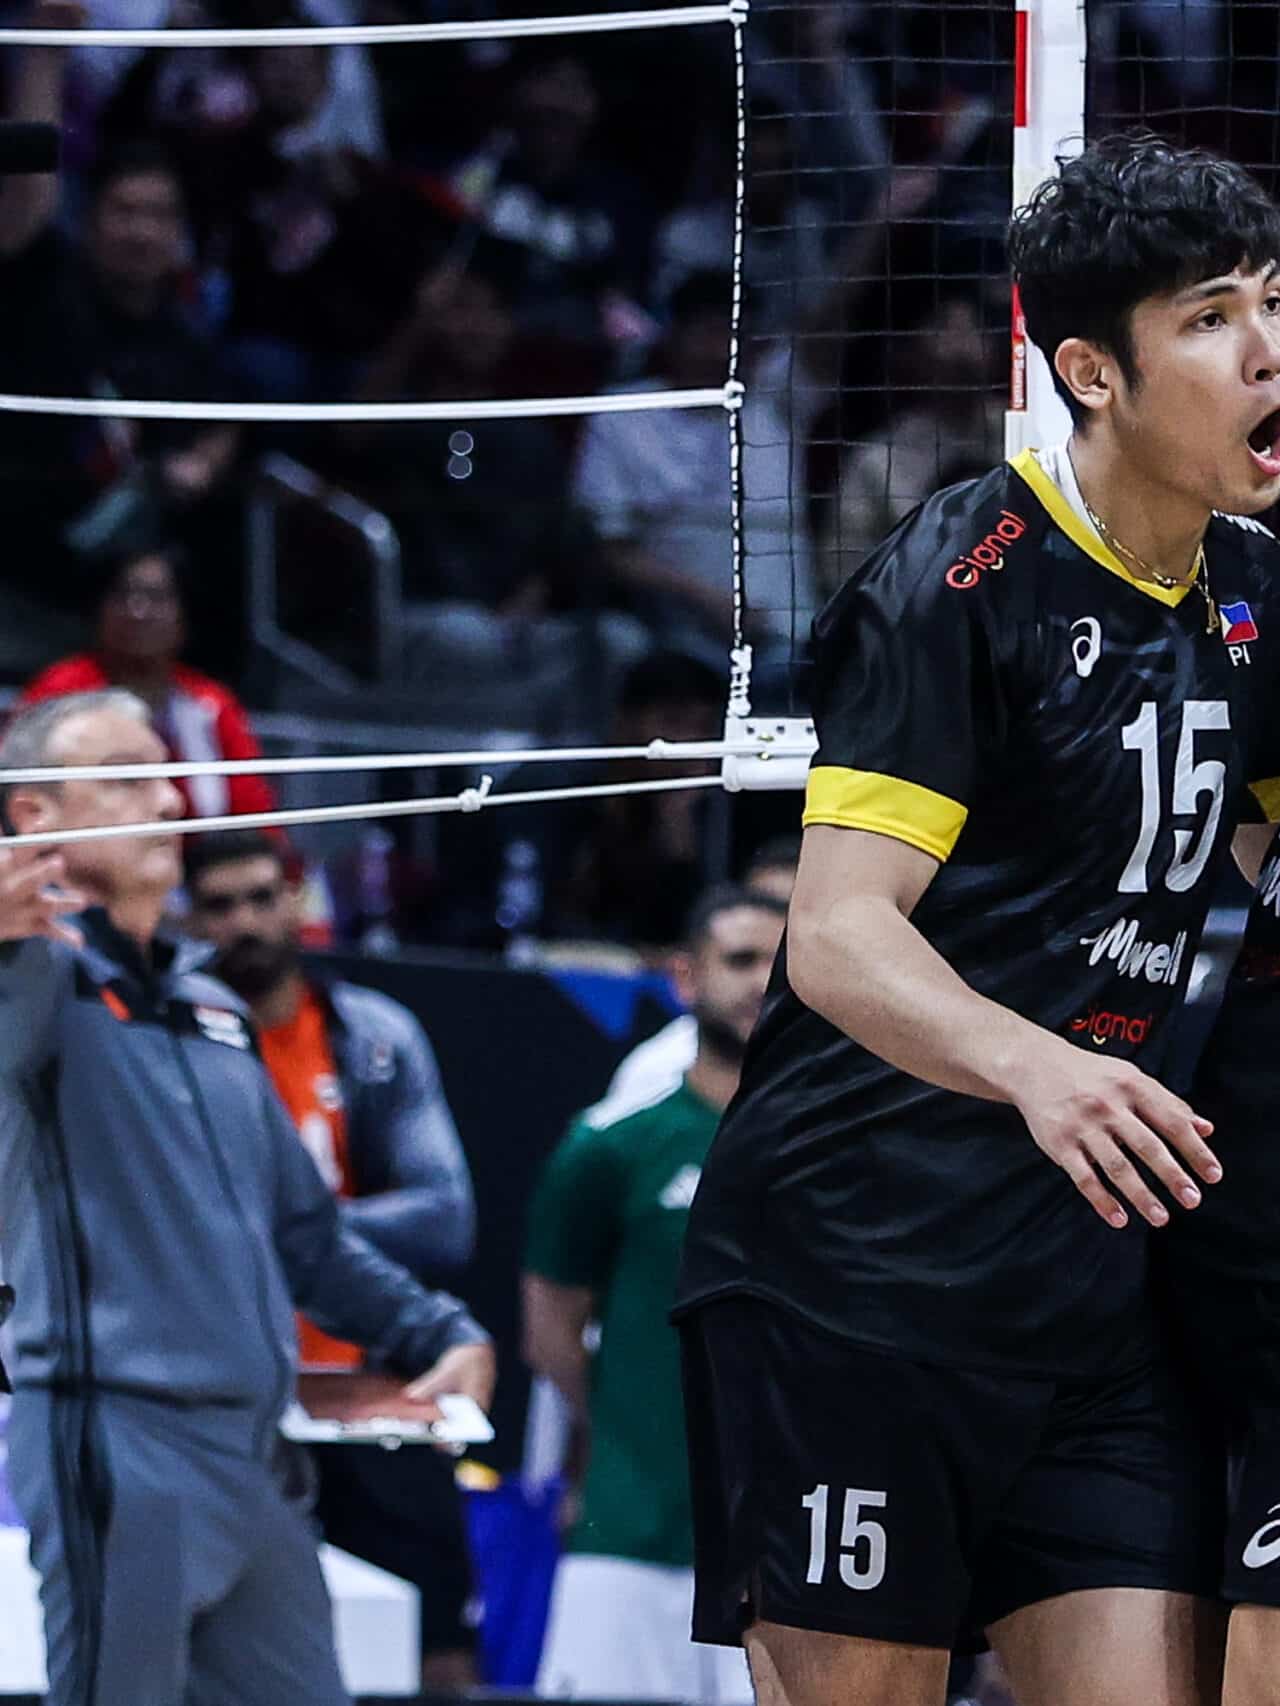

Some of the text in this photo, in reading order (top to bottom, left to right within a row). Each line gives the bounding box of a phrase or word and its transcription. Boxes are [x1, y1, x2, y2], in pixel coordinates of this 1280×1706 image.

[1228, 643, 1251, 667] PI
[1117, 700, 1231, 893] 15
[1080, 917, 1187, 985] Mwell
[802, 1484, 887, 1590] 15
